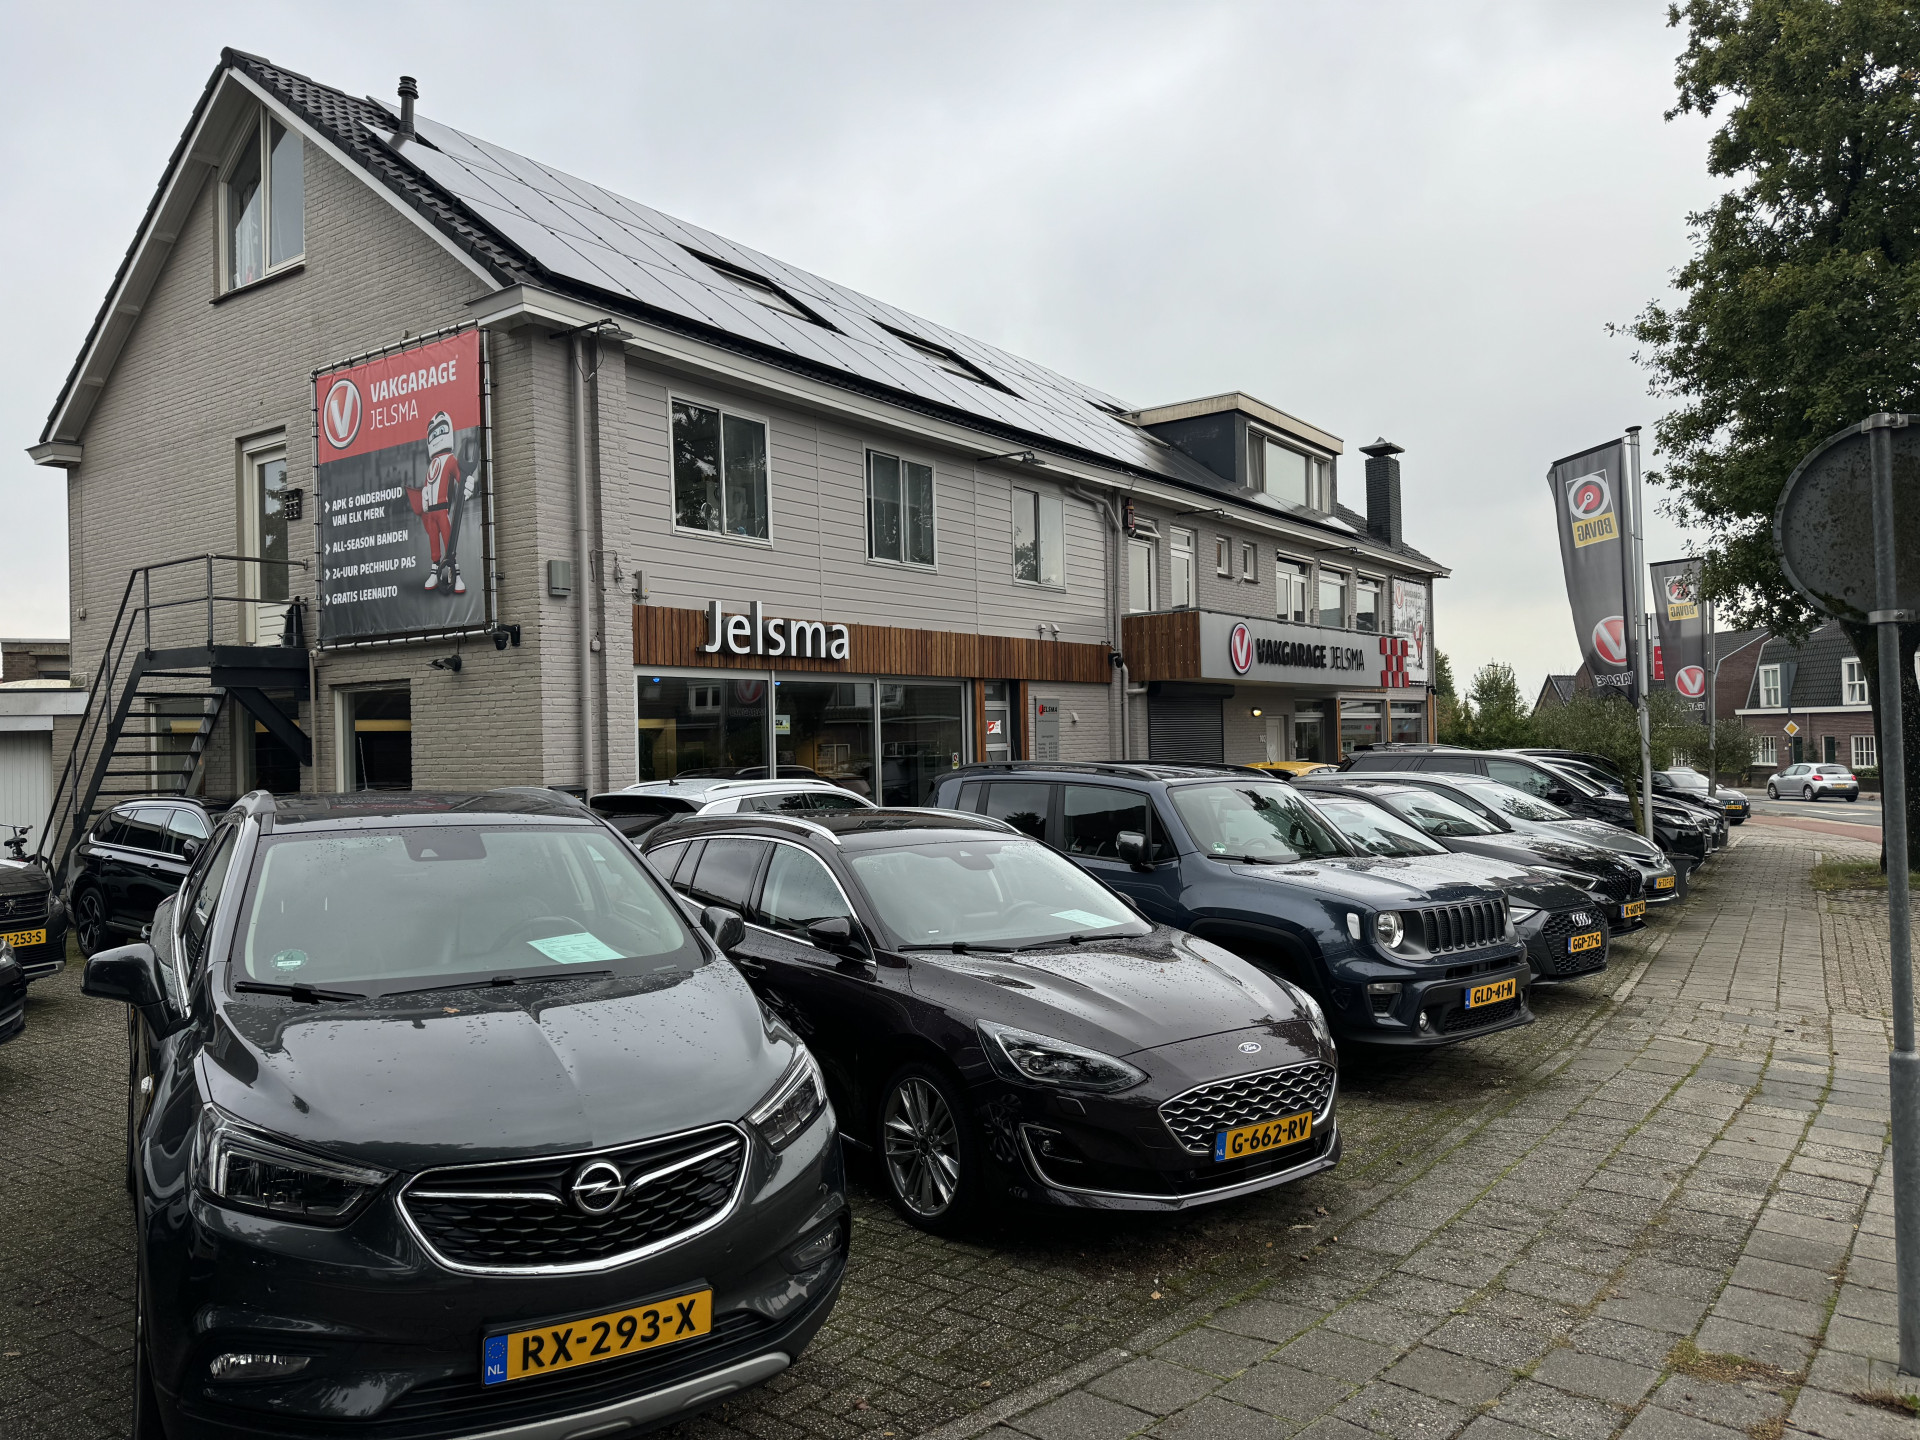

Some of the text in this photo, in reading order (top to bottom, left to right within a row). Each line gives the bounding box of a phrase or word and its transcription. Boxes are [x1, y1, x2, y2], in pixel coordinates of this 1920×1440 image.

[370, 360, 457, 403] VAKGARAGE
[370, 399, 418, 430] JELSMA
[332, 487, 403, 511] APK & ONDERHOUD
[332, 506, 385, 527] VAN ELK MERK
[332, 530, 408, 553] ALL-SEASON BANDEN
[332, 556, 416, 579] 24-UUR PECHHULP PAS
[332, 585, 398, 605] GRATIS LEENAUTO
[705, 601, 849, 660] Jelsma
[1256, 638, 1327, 668] VAKGARAGE
[1330, 646, 1365, 671] JELSMA
[1573, 934, 1599, 950] GGP-27-G
[1474, 981, 1513, 1004] GLD-41-N
[1232, 1116, 1308, 1154] G-662-RV
[487, 1299, 696, 1376] NL RX-293-X
